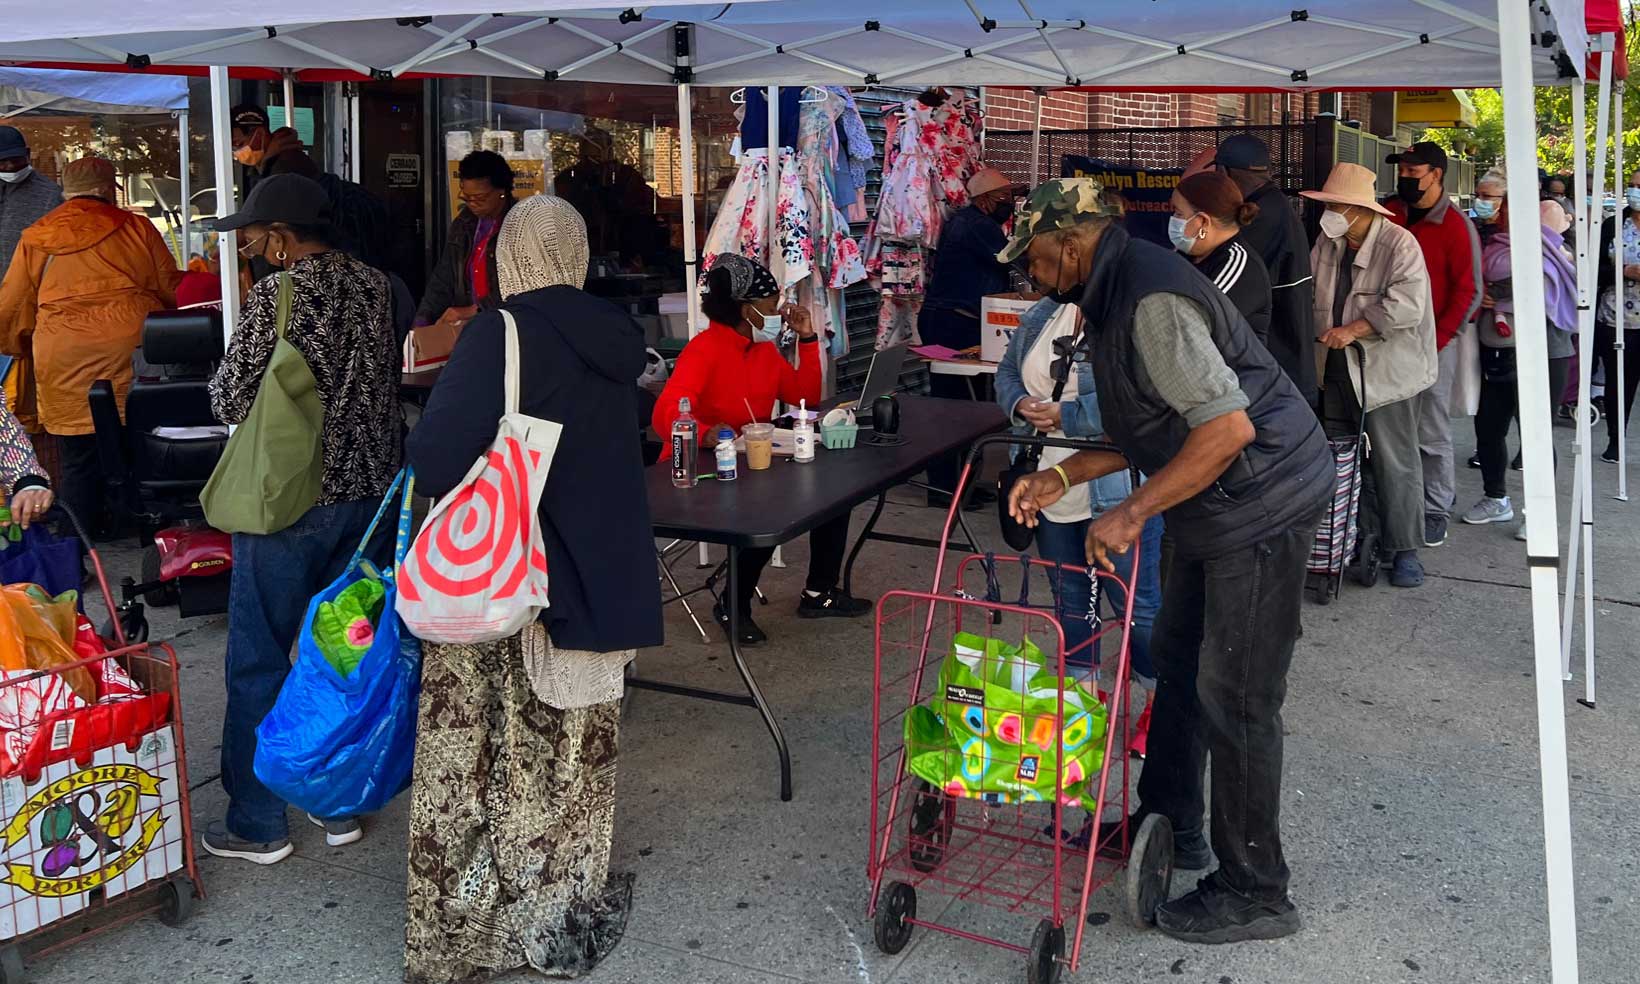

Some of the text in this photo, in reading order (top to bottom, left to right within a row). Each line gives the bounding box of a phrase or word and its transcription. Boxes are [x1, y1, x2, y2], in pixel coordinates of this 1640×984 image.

[1074, 169, 1133, 191] Boklyn
[28, 767, 138, 812] MOORE
[33, 842, 146, 894] PORTER
